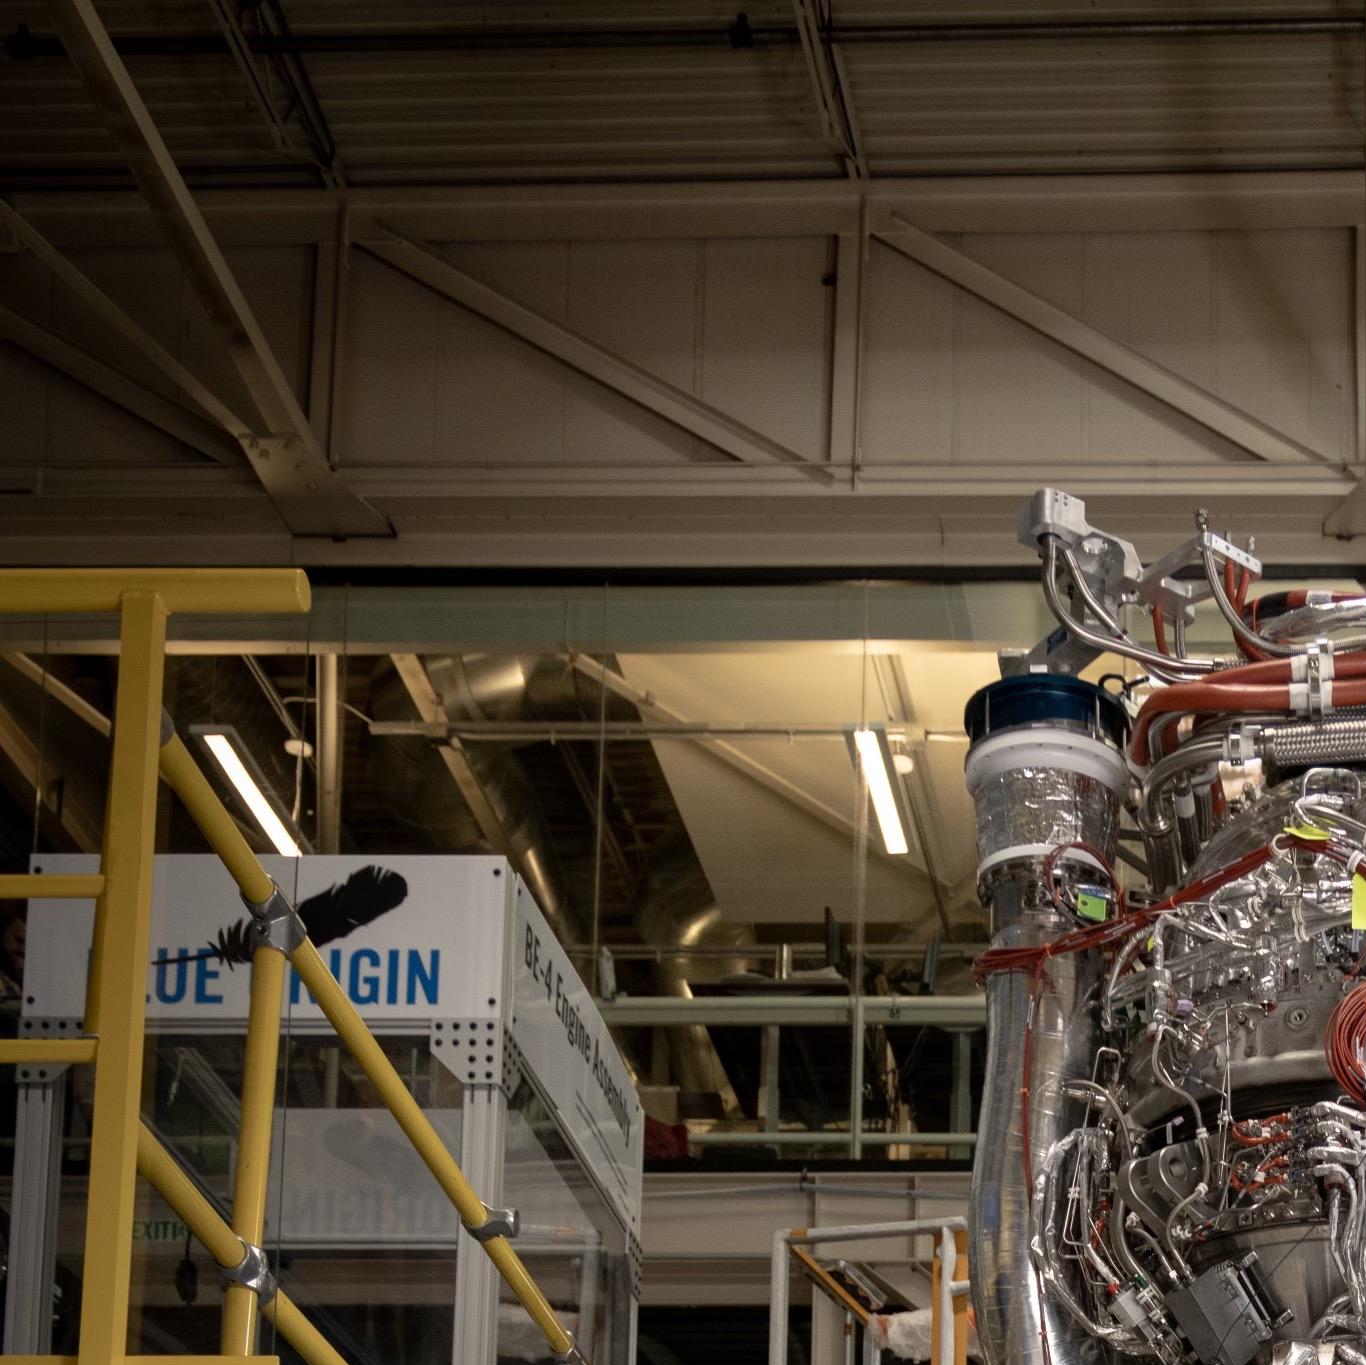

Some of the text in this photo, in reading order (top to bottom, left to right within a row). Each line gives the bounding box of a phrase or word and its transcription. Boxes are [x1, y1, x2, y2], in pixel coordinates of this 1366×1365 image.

[524, 922, 553, 1004] BE-4
[555, 971, 591, 1064] Engine
[592, 1038, 631, 1149] Assembly
